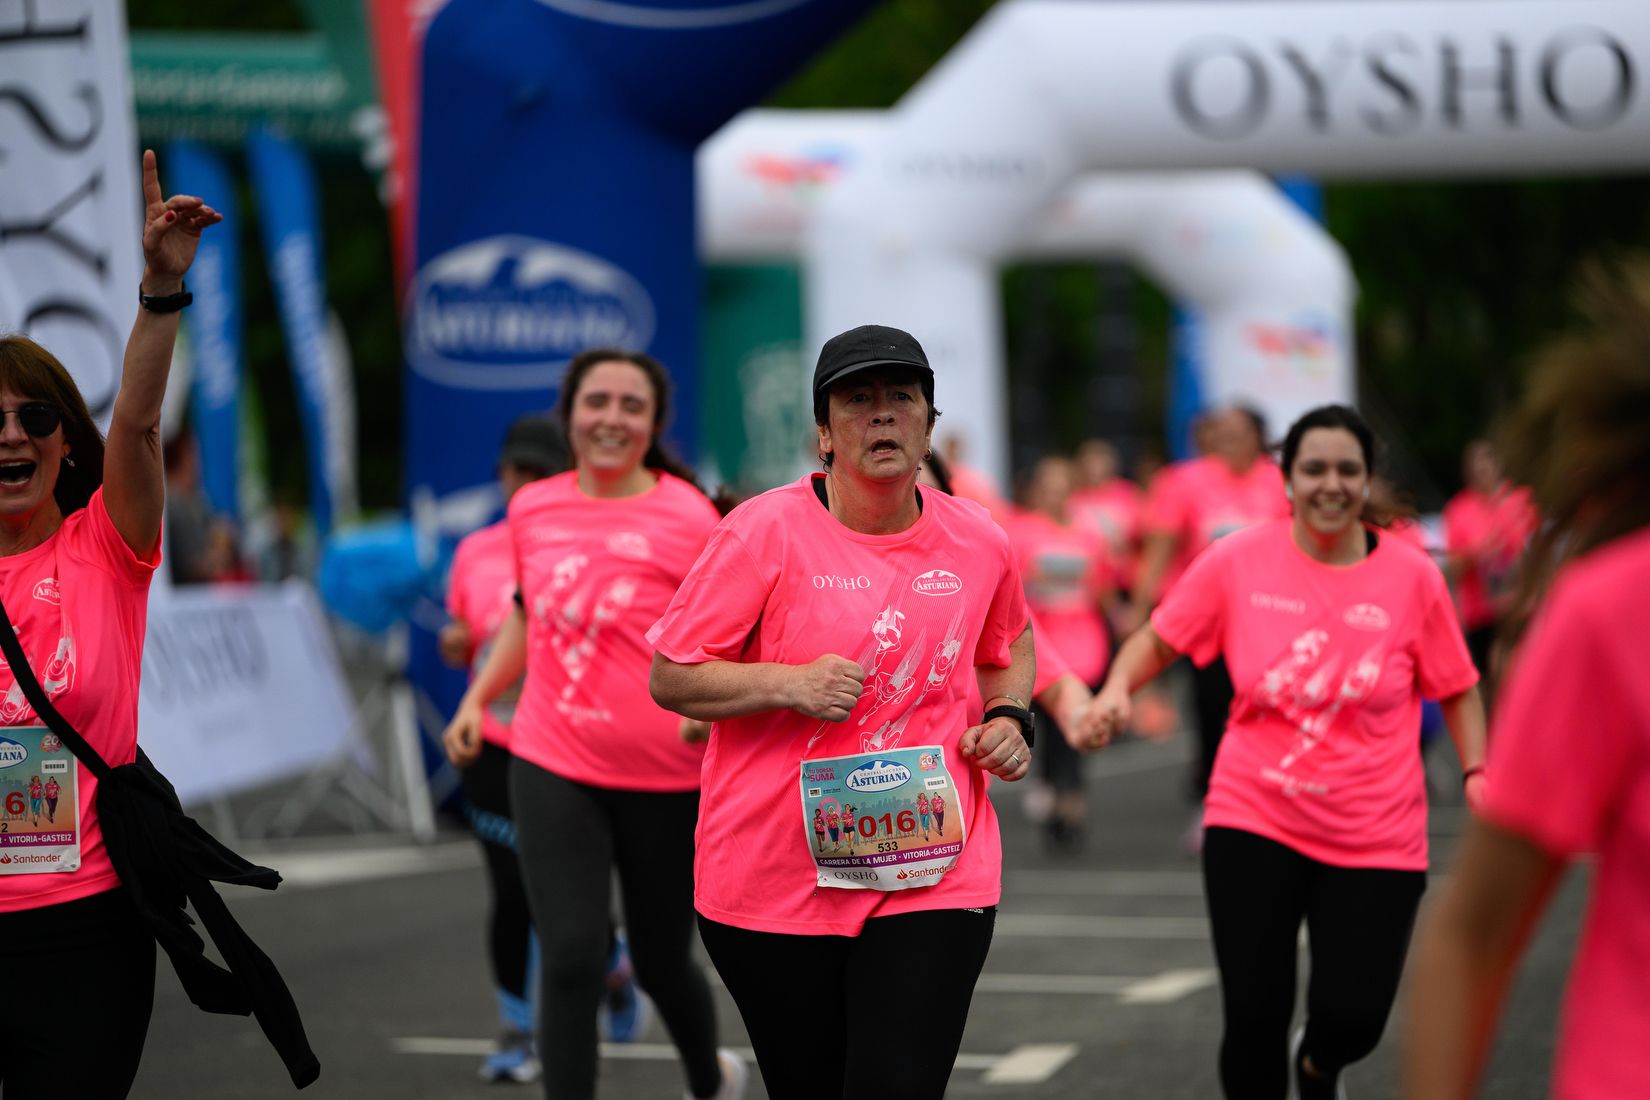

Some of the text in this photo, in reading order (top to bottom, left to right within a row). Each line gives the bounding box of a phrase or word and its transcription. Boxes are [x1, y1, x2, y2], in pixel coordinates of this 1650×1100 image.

[1168, 24, 1638, 142] OYSHO
[813, 575, 871, 590] OYSHO
[916, 581, 959, 590] ASTURIANA
[809, 773, 835, 782] SUMA
[851, 772, 909, 787] ASTURIANA
[5, 791, 25, 815] 6
[858, 810, 916, 838] 016
[9, 833, 72, 843] VITORIA-GASTEIZ
[878, 841, 898, 852] 533
[13, 853, 62, 864] Santander
[820, 858, 850, 866] CARRERA
[873, 854, 897, 864] MUJER
[903, 844, 960, 859] VITORIA-GASTEIZ
[834, 871, 879, 882] OYSHO
